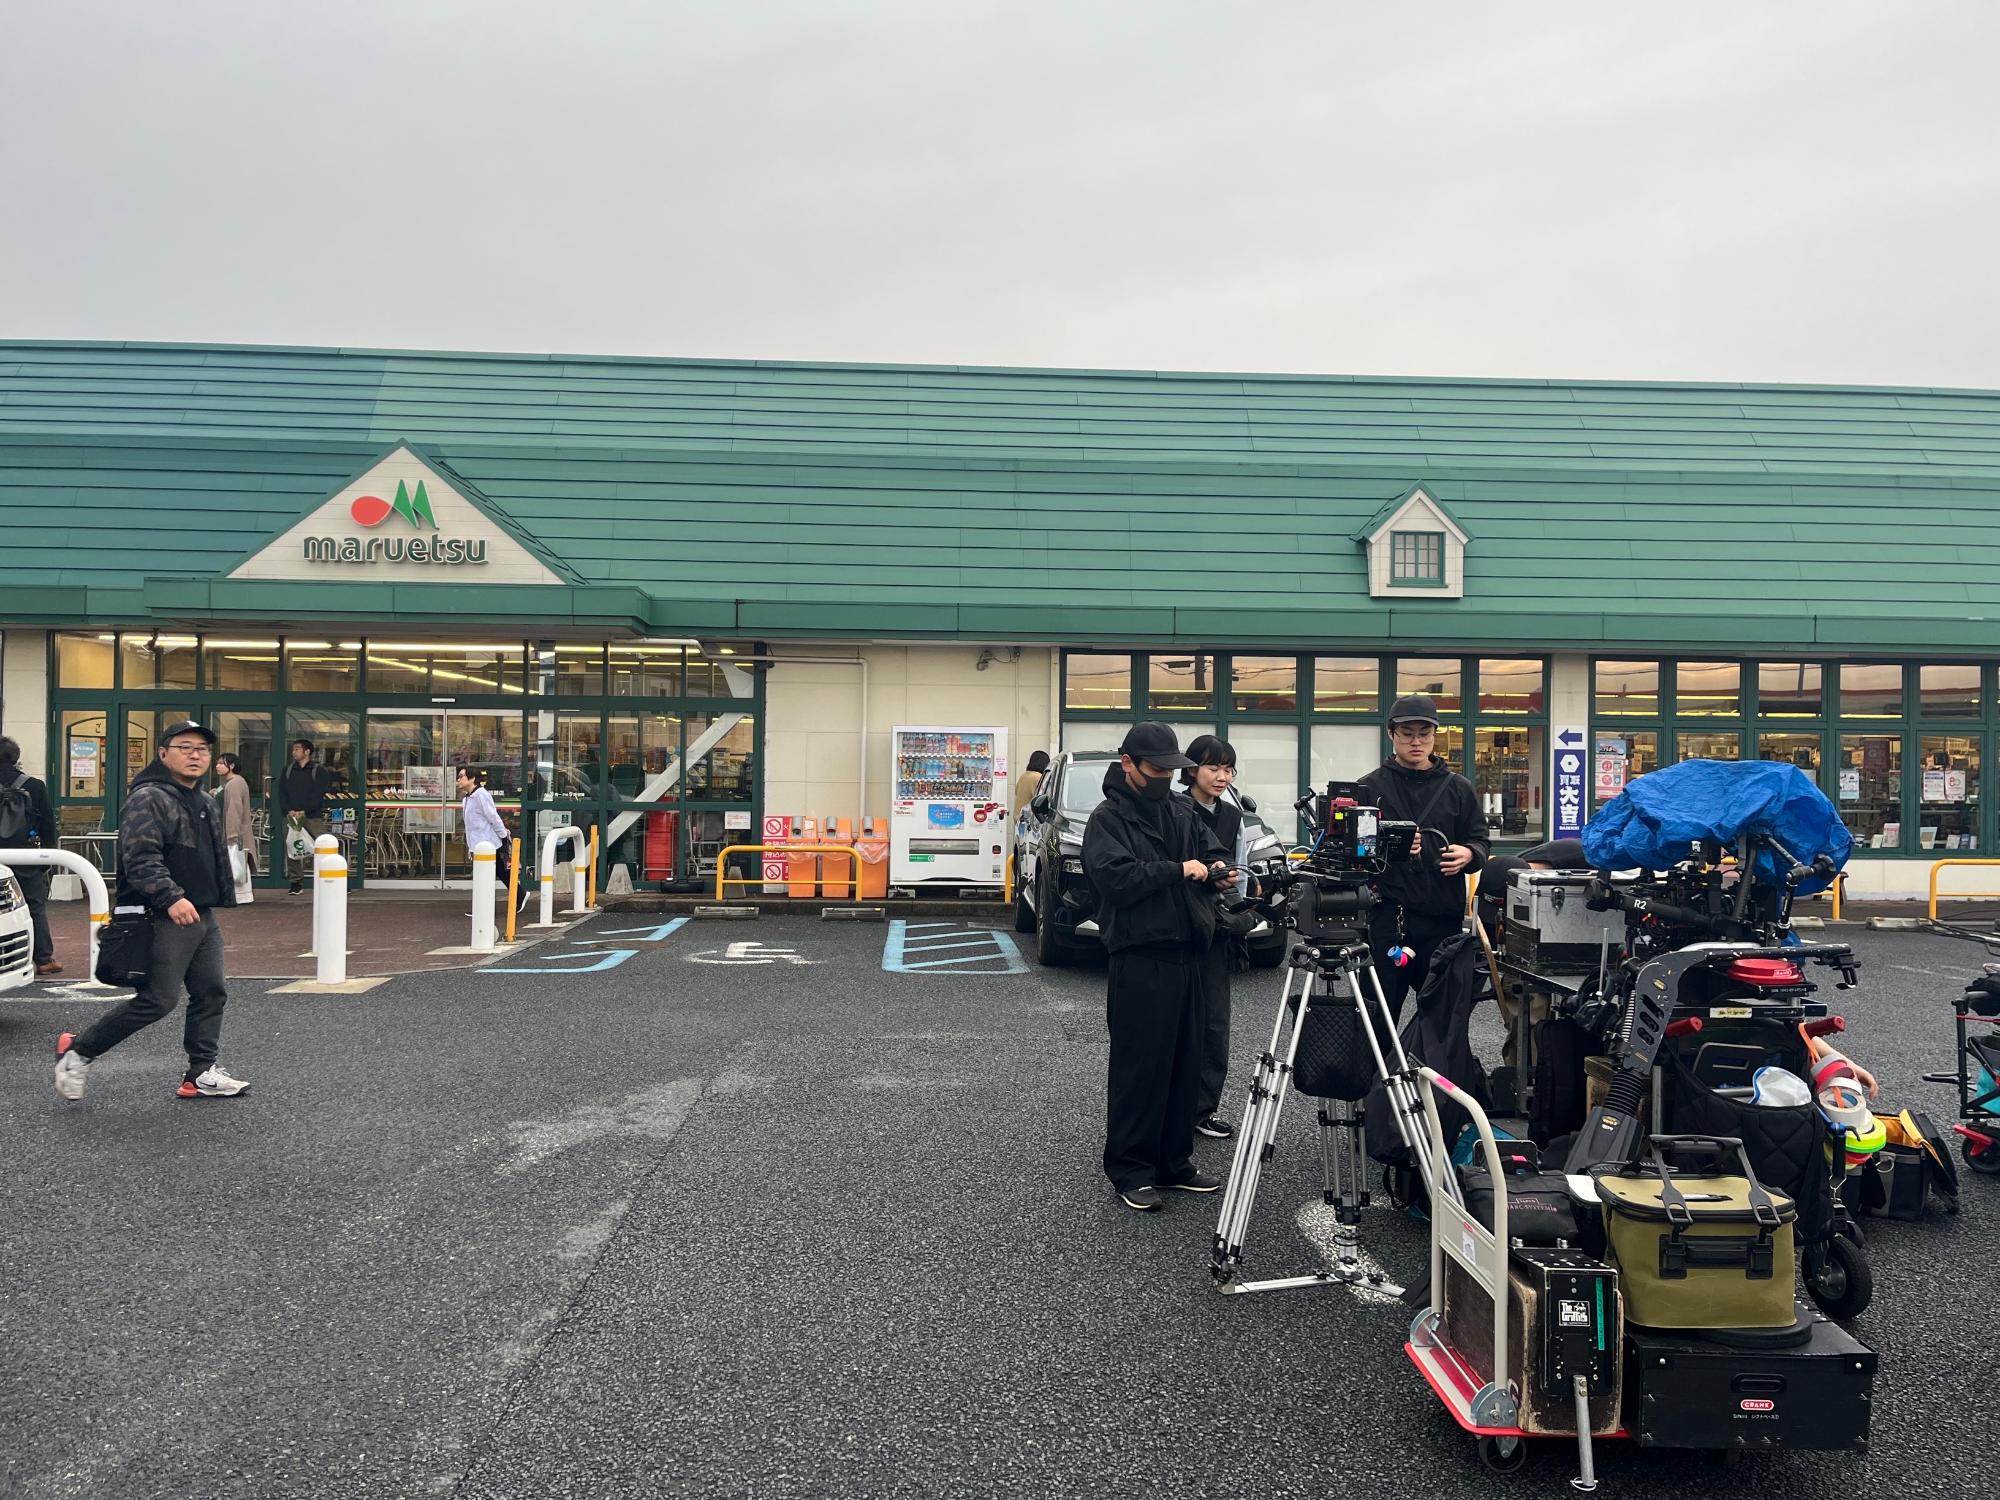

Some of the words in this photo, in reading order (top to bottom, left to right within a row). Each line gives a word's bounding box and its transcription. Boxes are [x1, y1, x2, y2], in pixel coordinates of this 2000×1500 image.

[303, 534, 488, 564] maruetsu
[1559, 786, 1580, 824] 大吉
[1633, 899, 1647, 910] R2
[1744, 1401, 1770, 1409] CRANK
